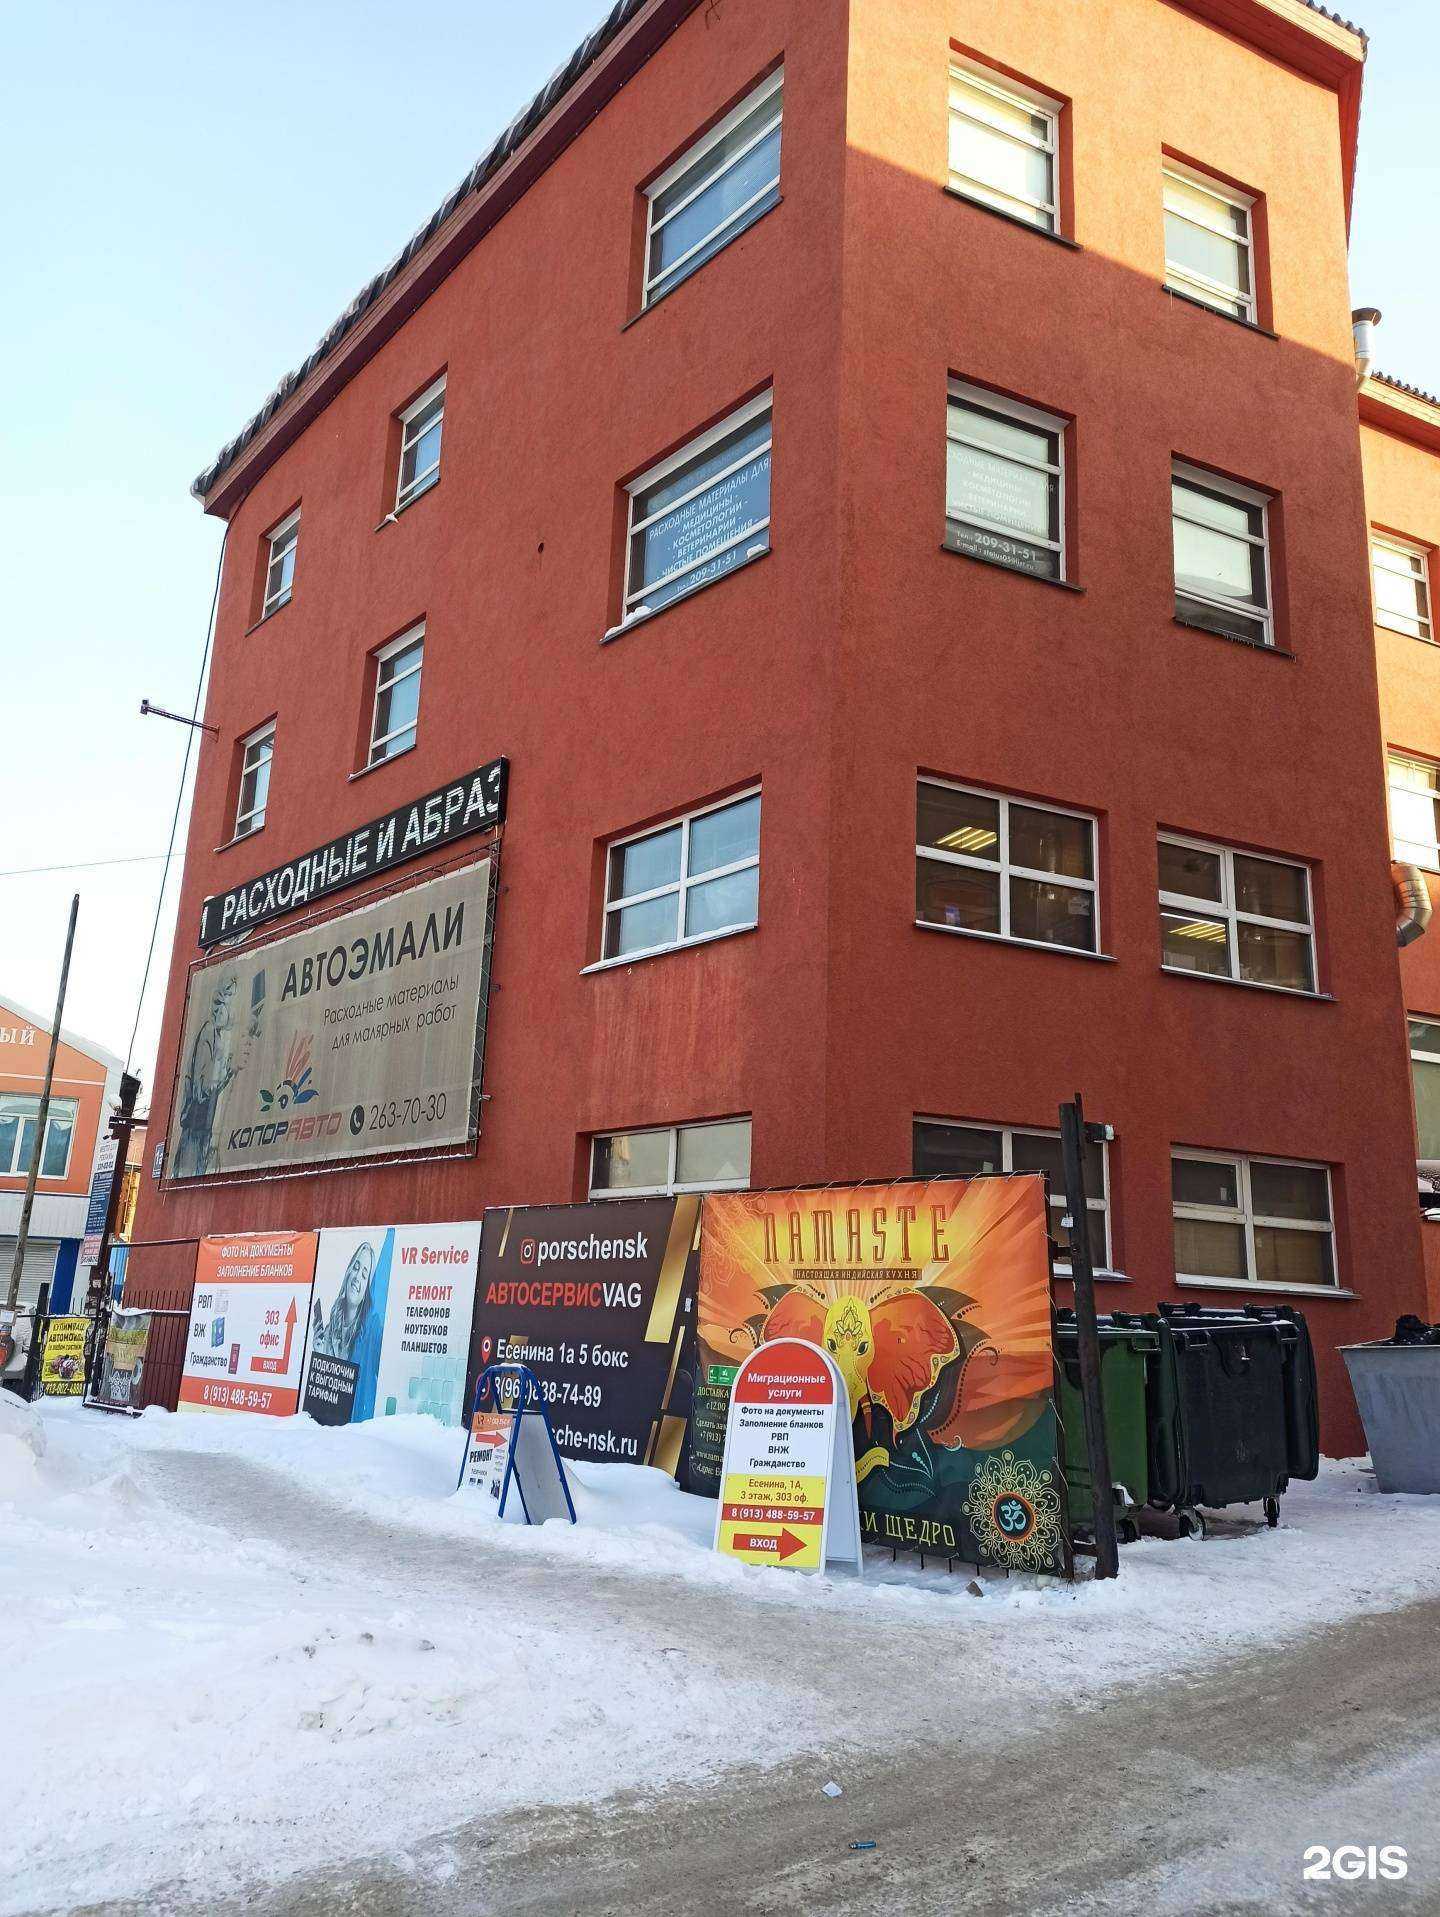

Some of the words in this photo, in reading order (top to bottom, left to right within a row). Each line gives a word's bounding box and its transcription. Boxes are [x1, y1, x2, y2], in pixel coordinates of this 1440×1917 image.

[649, 504, 696, 540] РАСХОДНЫЕ
[699, 474, 748, 510] МАТЕРИАЛЫ
[751, 458, 769, 481] ДЛЯ
[682, 496, 733, 532] МЕДИЦИНЫ
[673, 501, 742, 548] КОСМЕТОЛОГИИ
[678, 518, 736, 556] ВЕТЕРИНАРИИ
[975, 532, 1037, 560] 209-31-51
[690, 551, 737, 583] 209-31-51
[221, 829, 371, 931] РАСХОДНЫЕ
[281, 902, 464, 1001] АВТОЭМАЛИ
[324, 997, 383, 1026] Расходные
[387, 975, 459, 1006] материалы
[332, 1033, 350, 1051] для
[352, 1017, 410, 1041] малярных
[416, 1003, 457, 1032] работ
[369, 1093, 447, 1131] 263-70-30
[764, 1204, 950, 1265] NAMASTE
[221, 1246, 239, 1258] ФОТО
[241, 1245, 249, 1257] НА
[250, 1243, 294, 1259] ДОКУМЕНТЫ
[401, 1247, 418, 1265] VR
[420, 1245, 469, 1265] Service
[537, 1231, 648, 1266] porschensk
[217, 1265, 260, 1277] ЗАПОЛНЕНИЕ
[260, 1264, 293, 1277] БЛАНКОВ
[885, 1269, 918, 1279] КУХНЯ
[198, 1294, 213, 1309] РВП
[408, 1285, 453, 1301] РЕМОНТ
[264, 1310, 280, 1325] 303
[406, 1306, 450, 1319] ТЕЛЕФОНОВ
[404, 1323, 448, 1336] НОУТБУКОВ
[260, 1330, 280, 1350] офис
[401, 1340, 448, 1354] ПЛАНШЕТОВ
[190, 1351, 228, 1368] Гражданство
[497, 1338, 554, 1362] Есенина
[559, 1342, 575, 1364] 1а
[579, 1343, 588, 1365] 5
[592, 1344, 629, 1368] бокс
[312, 1357, 355, 1381] ПОДКЛЮЧИМ
[309, 1374, 314, 1384] К
[315, 1374, 354, 1395] ВЫГОДНЫМ
[747, 1372, 826, 1386] Миграционные
[204, 1386, 209, 1400] 8
[209, 1386, 230, 1405] (913)
[230, 1389, 272, 1409] 488-59-57
[308, 1384, 339, 1405] ТАРИФАМ
[768, 1388, 802, 1399] услуги
[741, 1406, 762, 1416] Фото
[764, 1408, 774, 1416] на
[776, 1407, 824, 1418] документы
[739, 1419, 788, 1429] Заполнение
[789, 1419, 824, 1429] бланков
[771, 1432, 789, 1442] РВП
[768, 1445, 789, 1455] ВНЖ
[749, 1458, 806, 1469] Гражданство
[748, 1479, 787, 1491] Есенина,
[741, 1491, 746, 1500] 3
[748, 1492, 773, 1503] этаж,
[775, 1492, 792, 1502] 303
[794, 1493, 809, 1504] оф.
[731, 1508, 737, 1518] 8
[739, 1508, 764, 1520] (913)
[766, 1509, 815, 1521] 488-59-57
[885, 1514, 955, 1547] ЩЕДРО
[750, 1537, 778, 1550] ВХОД
